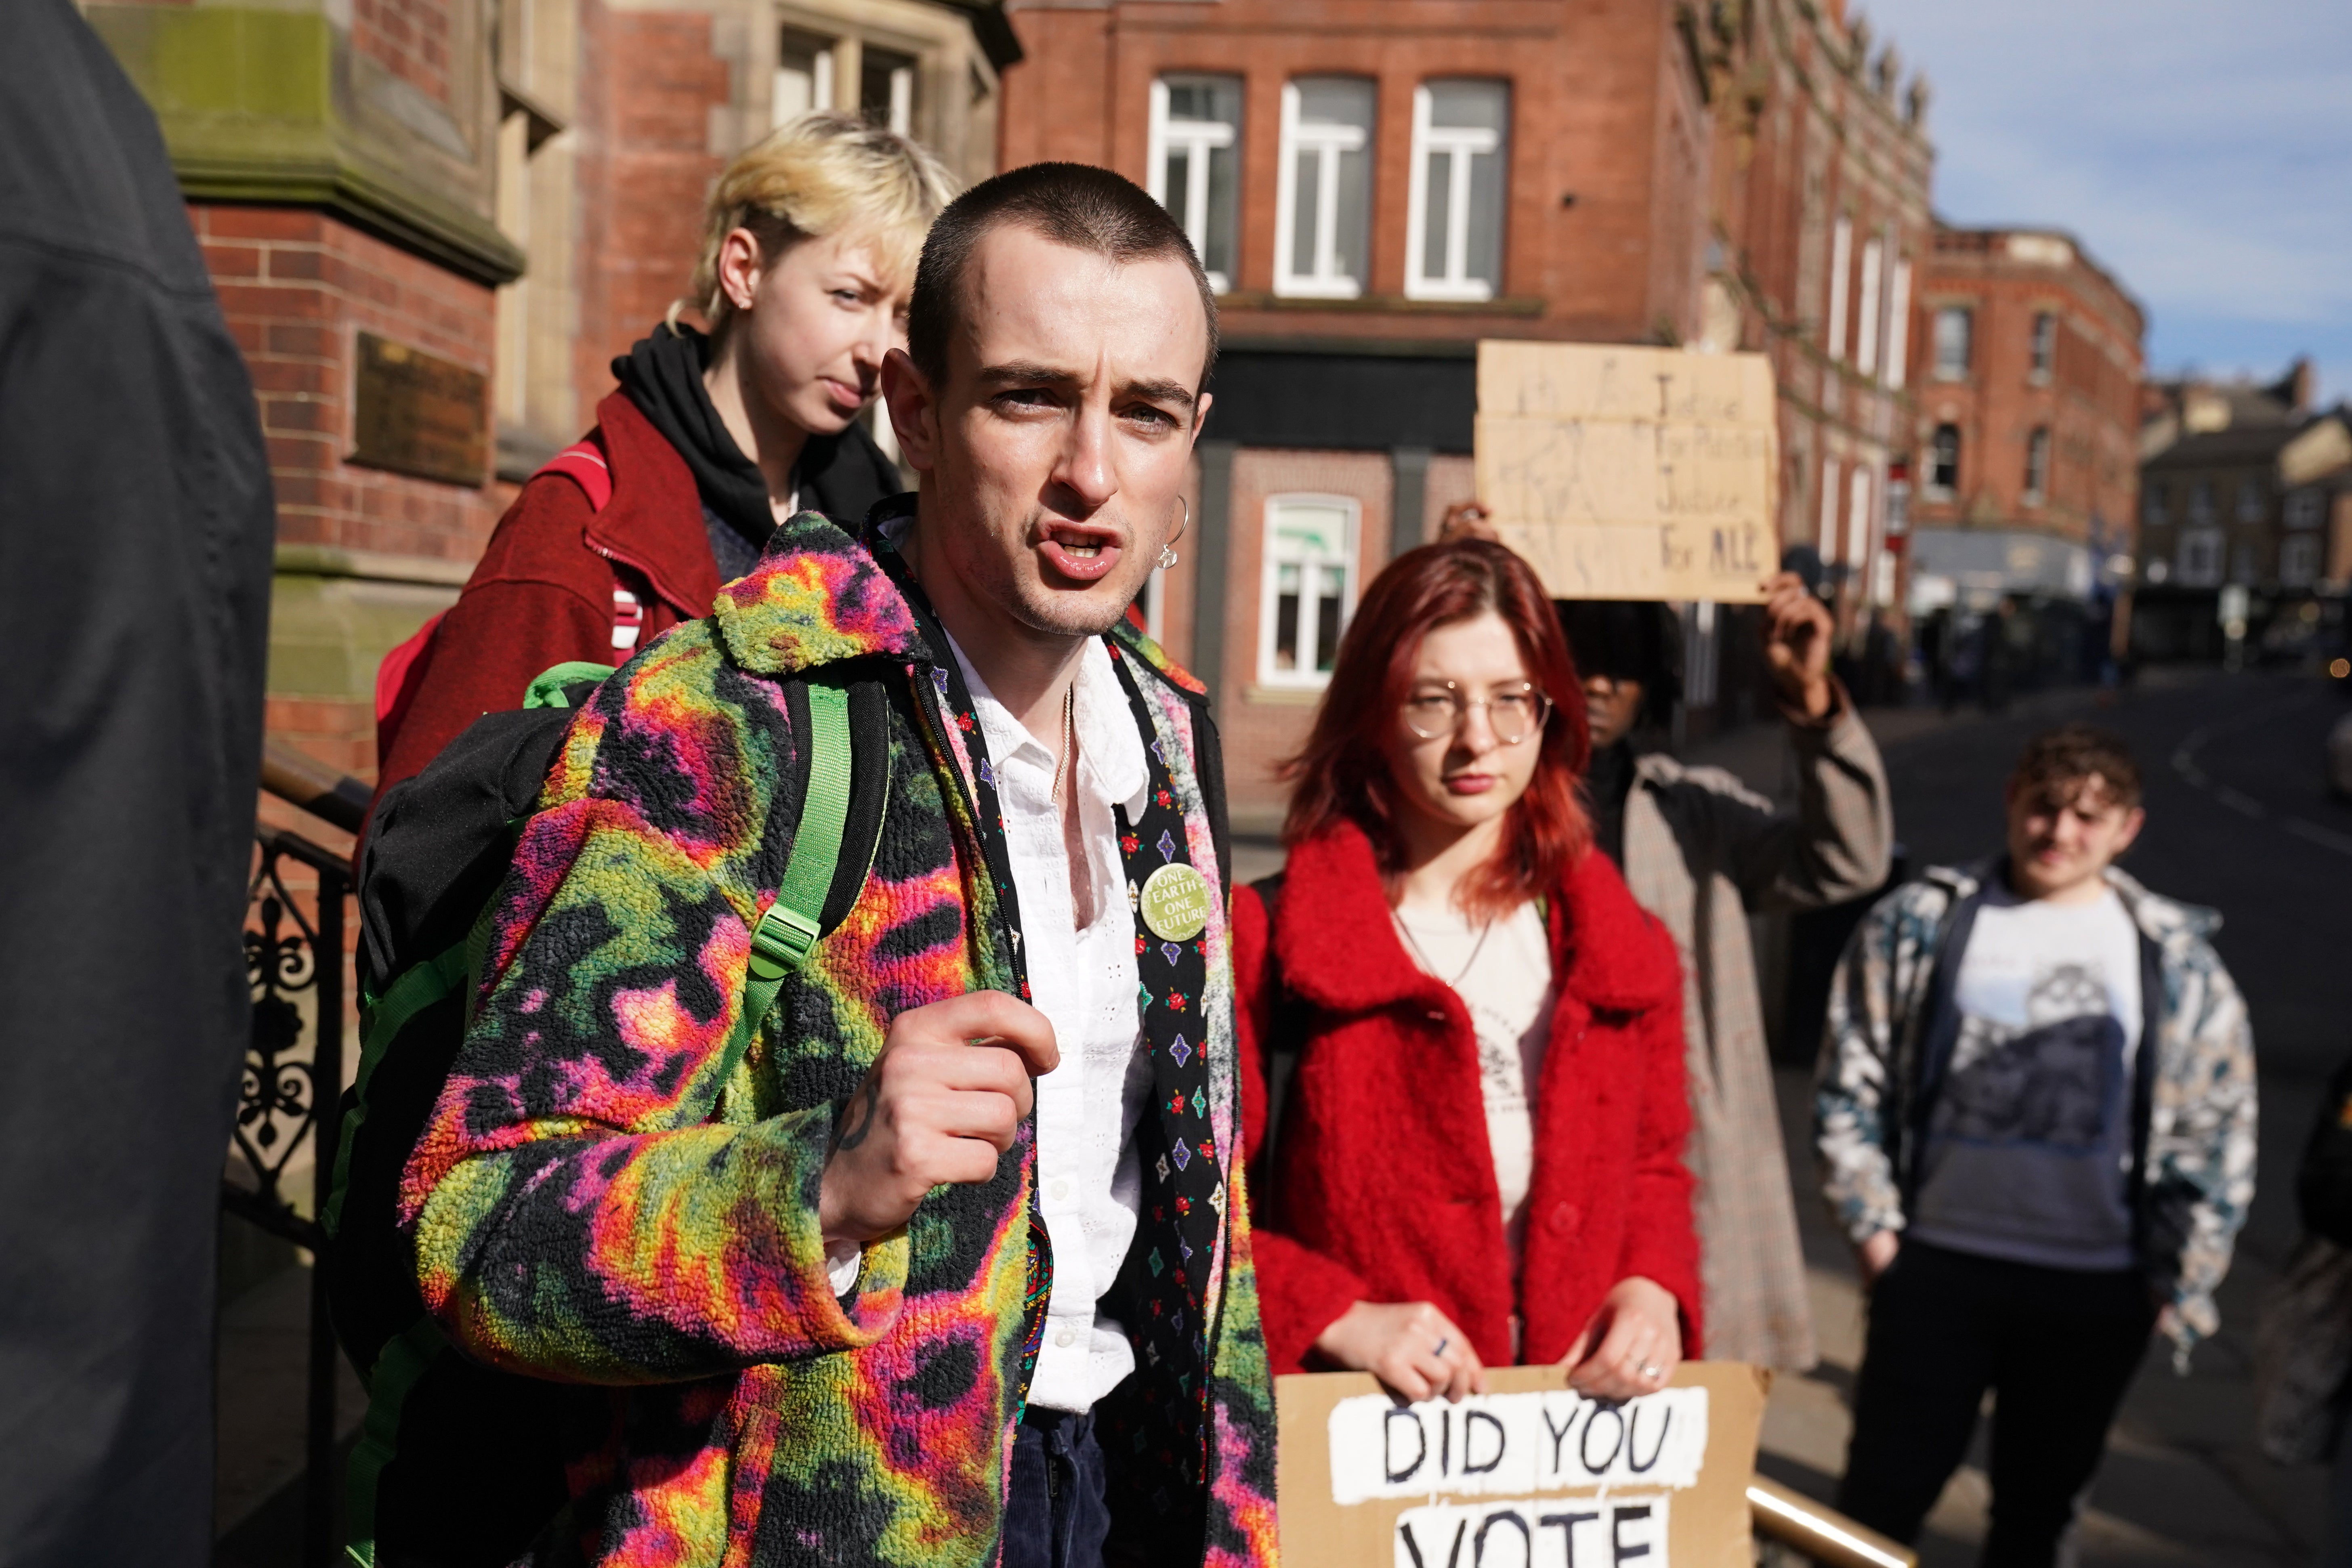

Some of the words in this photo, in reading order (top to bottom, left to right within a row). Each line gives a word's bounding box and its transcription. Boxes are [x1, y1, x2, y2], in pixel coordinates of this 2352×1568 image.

[1709, 523, 1758, 569] ALL
[1152, 879, 1197, 903] EARTH
[1157, 869, 1186, 887] ONE
[1164, 896, 1193, 915] ONE
[1156, 906, 1205, 932] FUTURE
[1384, 1407, 1506, 1483] DID
[1542, 1402, 1671, 1475] YOU
[1399, 1506, 1651, 1568] VOTE
